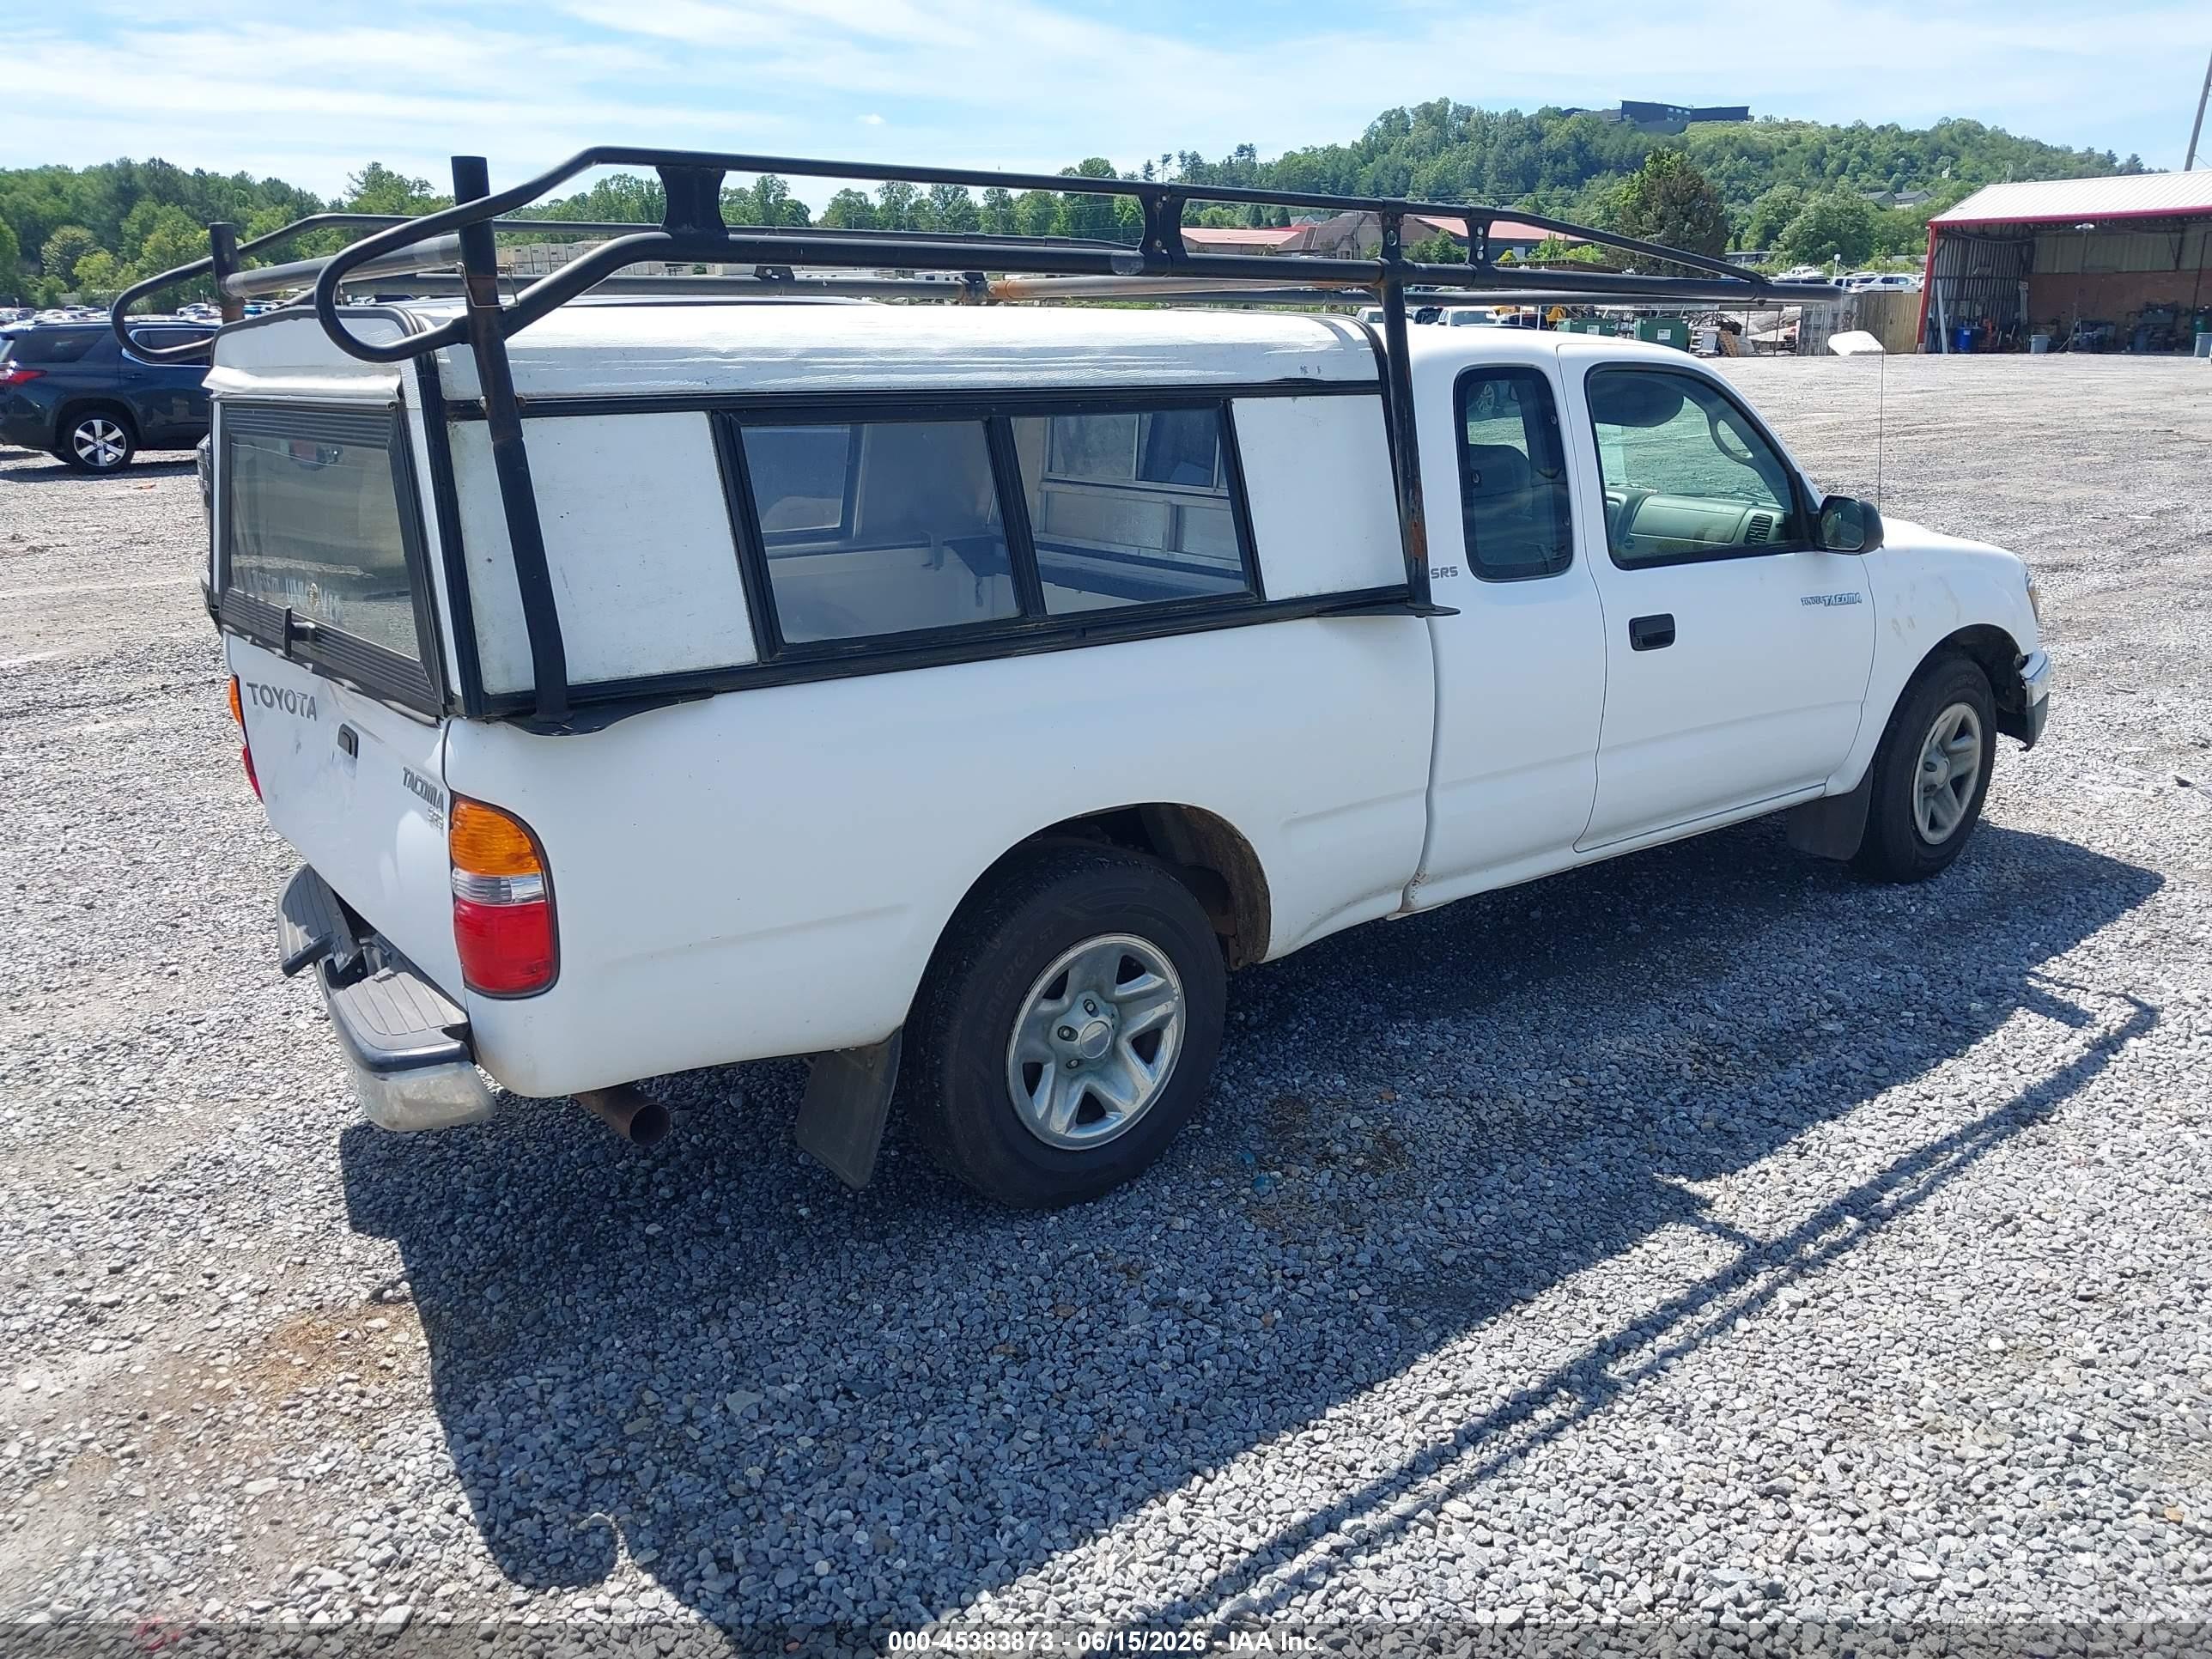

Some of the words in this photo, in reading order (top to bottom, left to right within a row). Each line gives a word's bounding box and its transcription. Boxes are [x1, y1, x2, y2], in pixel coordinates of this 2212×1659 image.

[1822, 592, 1863, 607] TACOMA
[246, 682, 318, 721] TOYOTA
[403, 766, 445, 813] TACOMA
